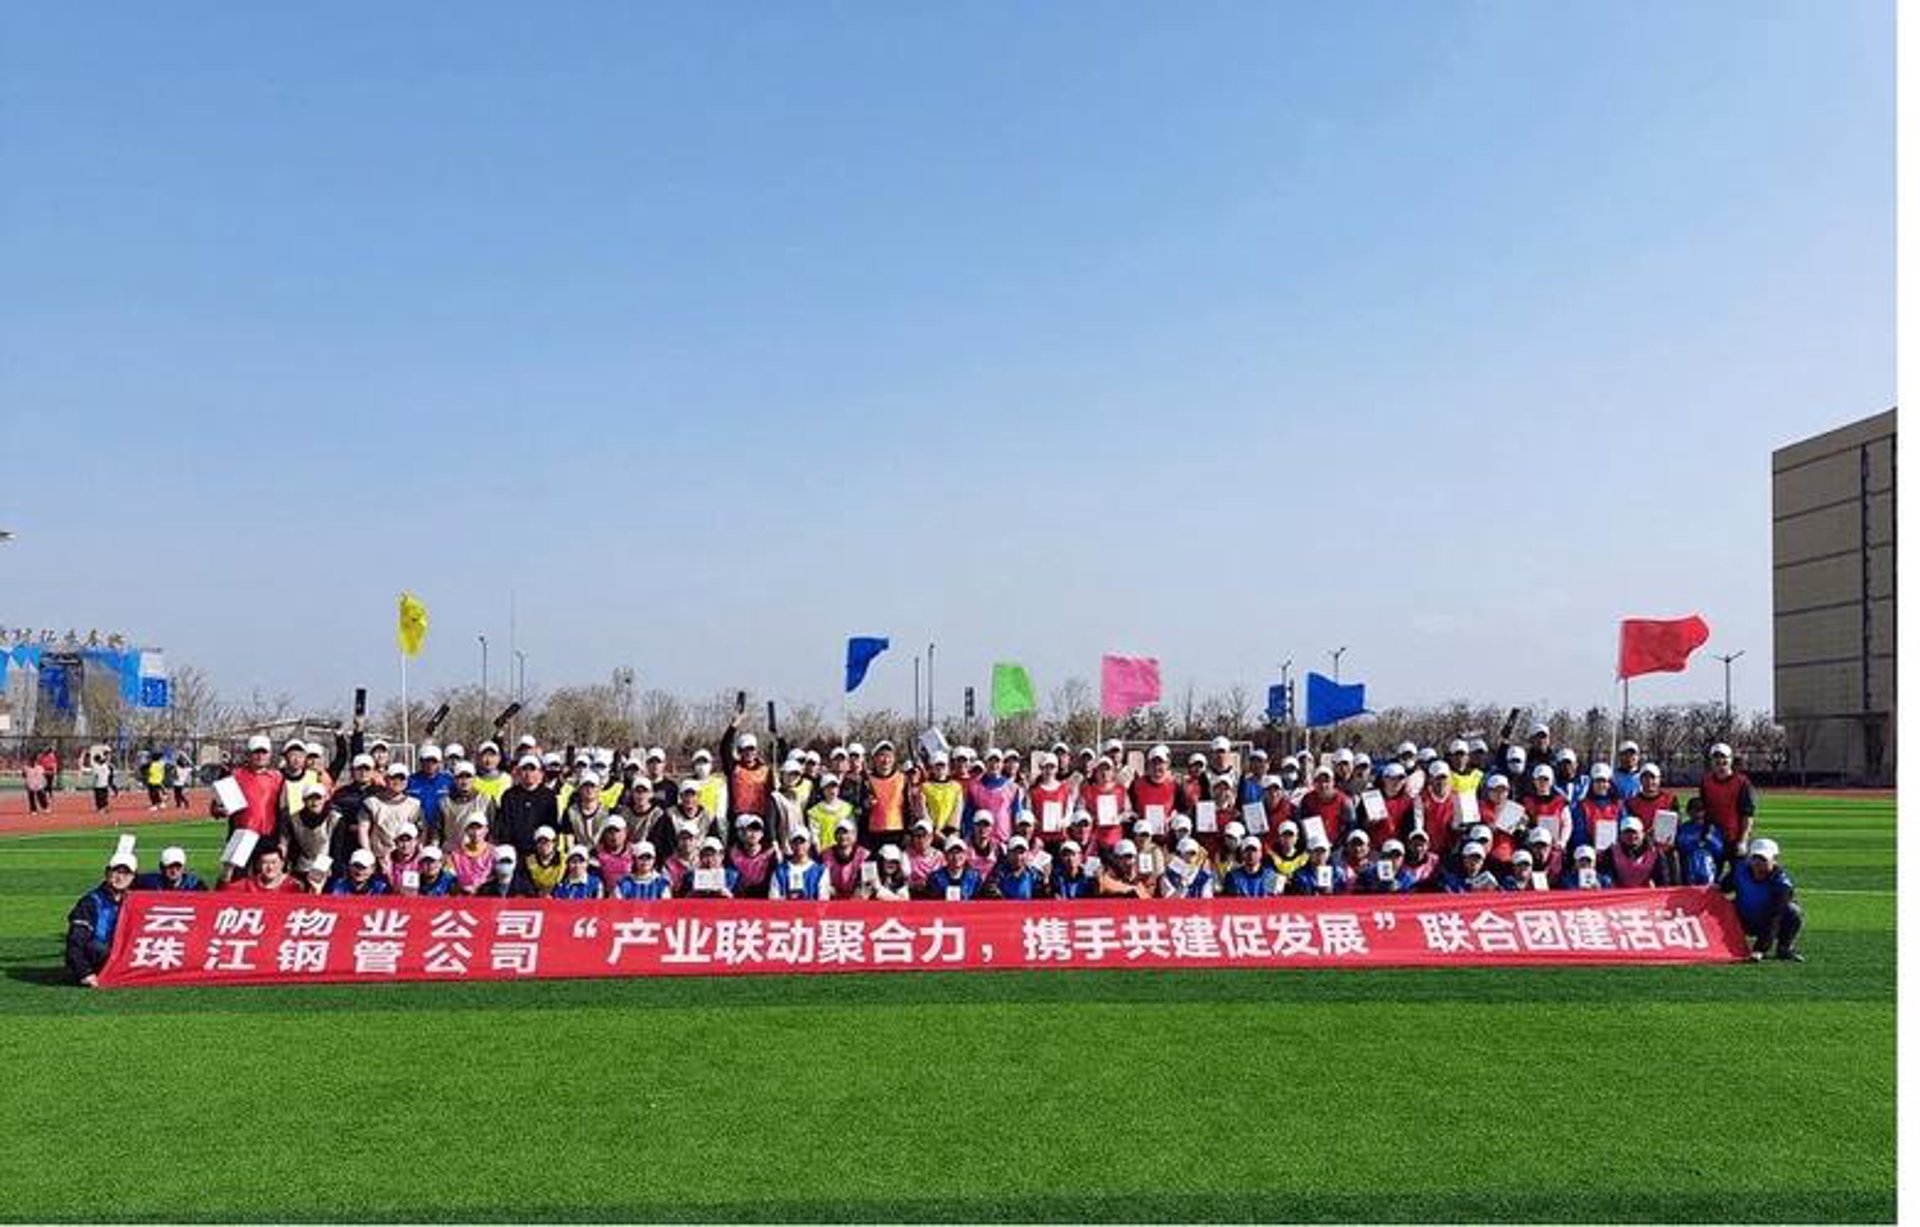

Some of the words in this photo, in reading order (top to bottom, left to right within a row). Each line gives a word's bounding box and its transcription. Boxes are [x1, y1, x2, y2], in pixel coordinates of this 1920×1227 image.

[143, 906, 544, 938] 云帆物业公司
[130, 936, 539, 974] 珠江钢管公司
